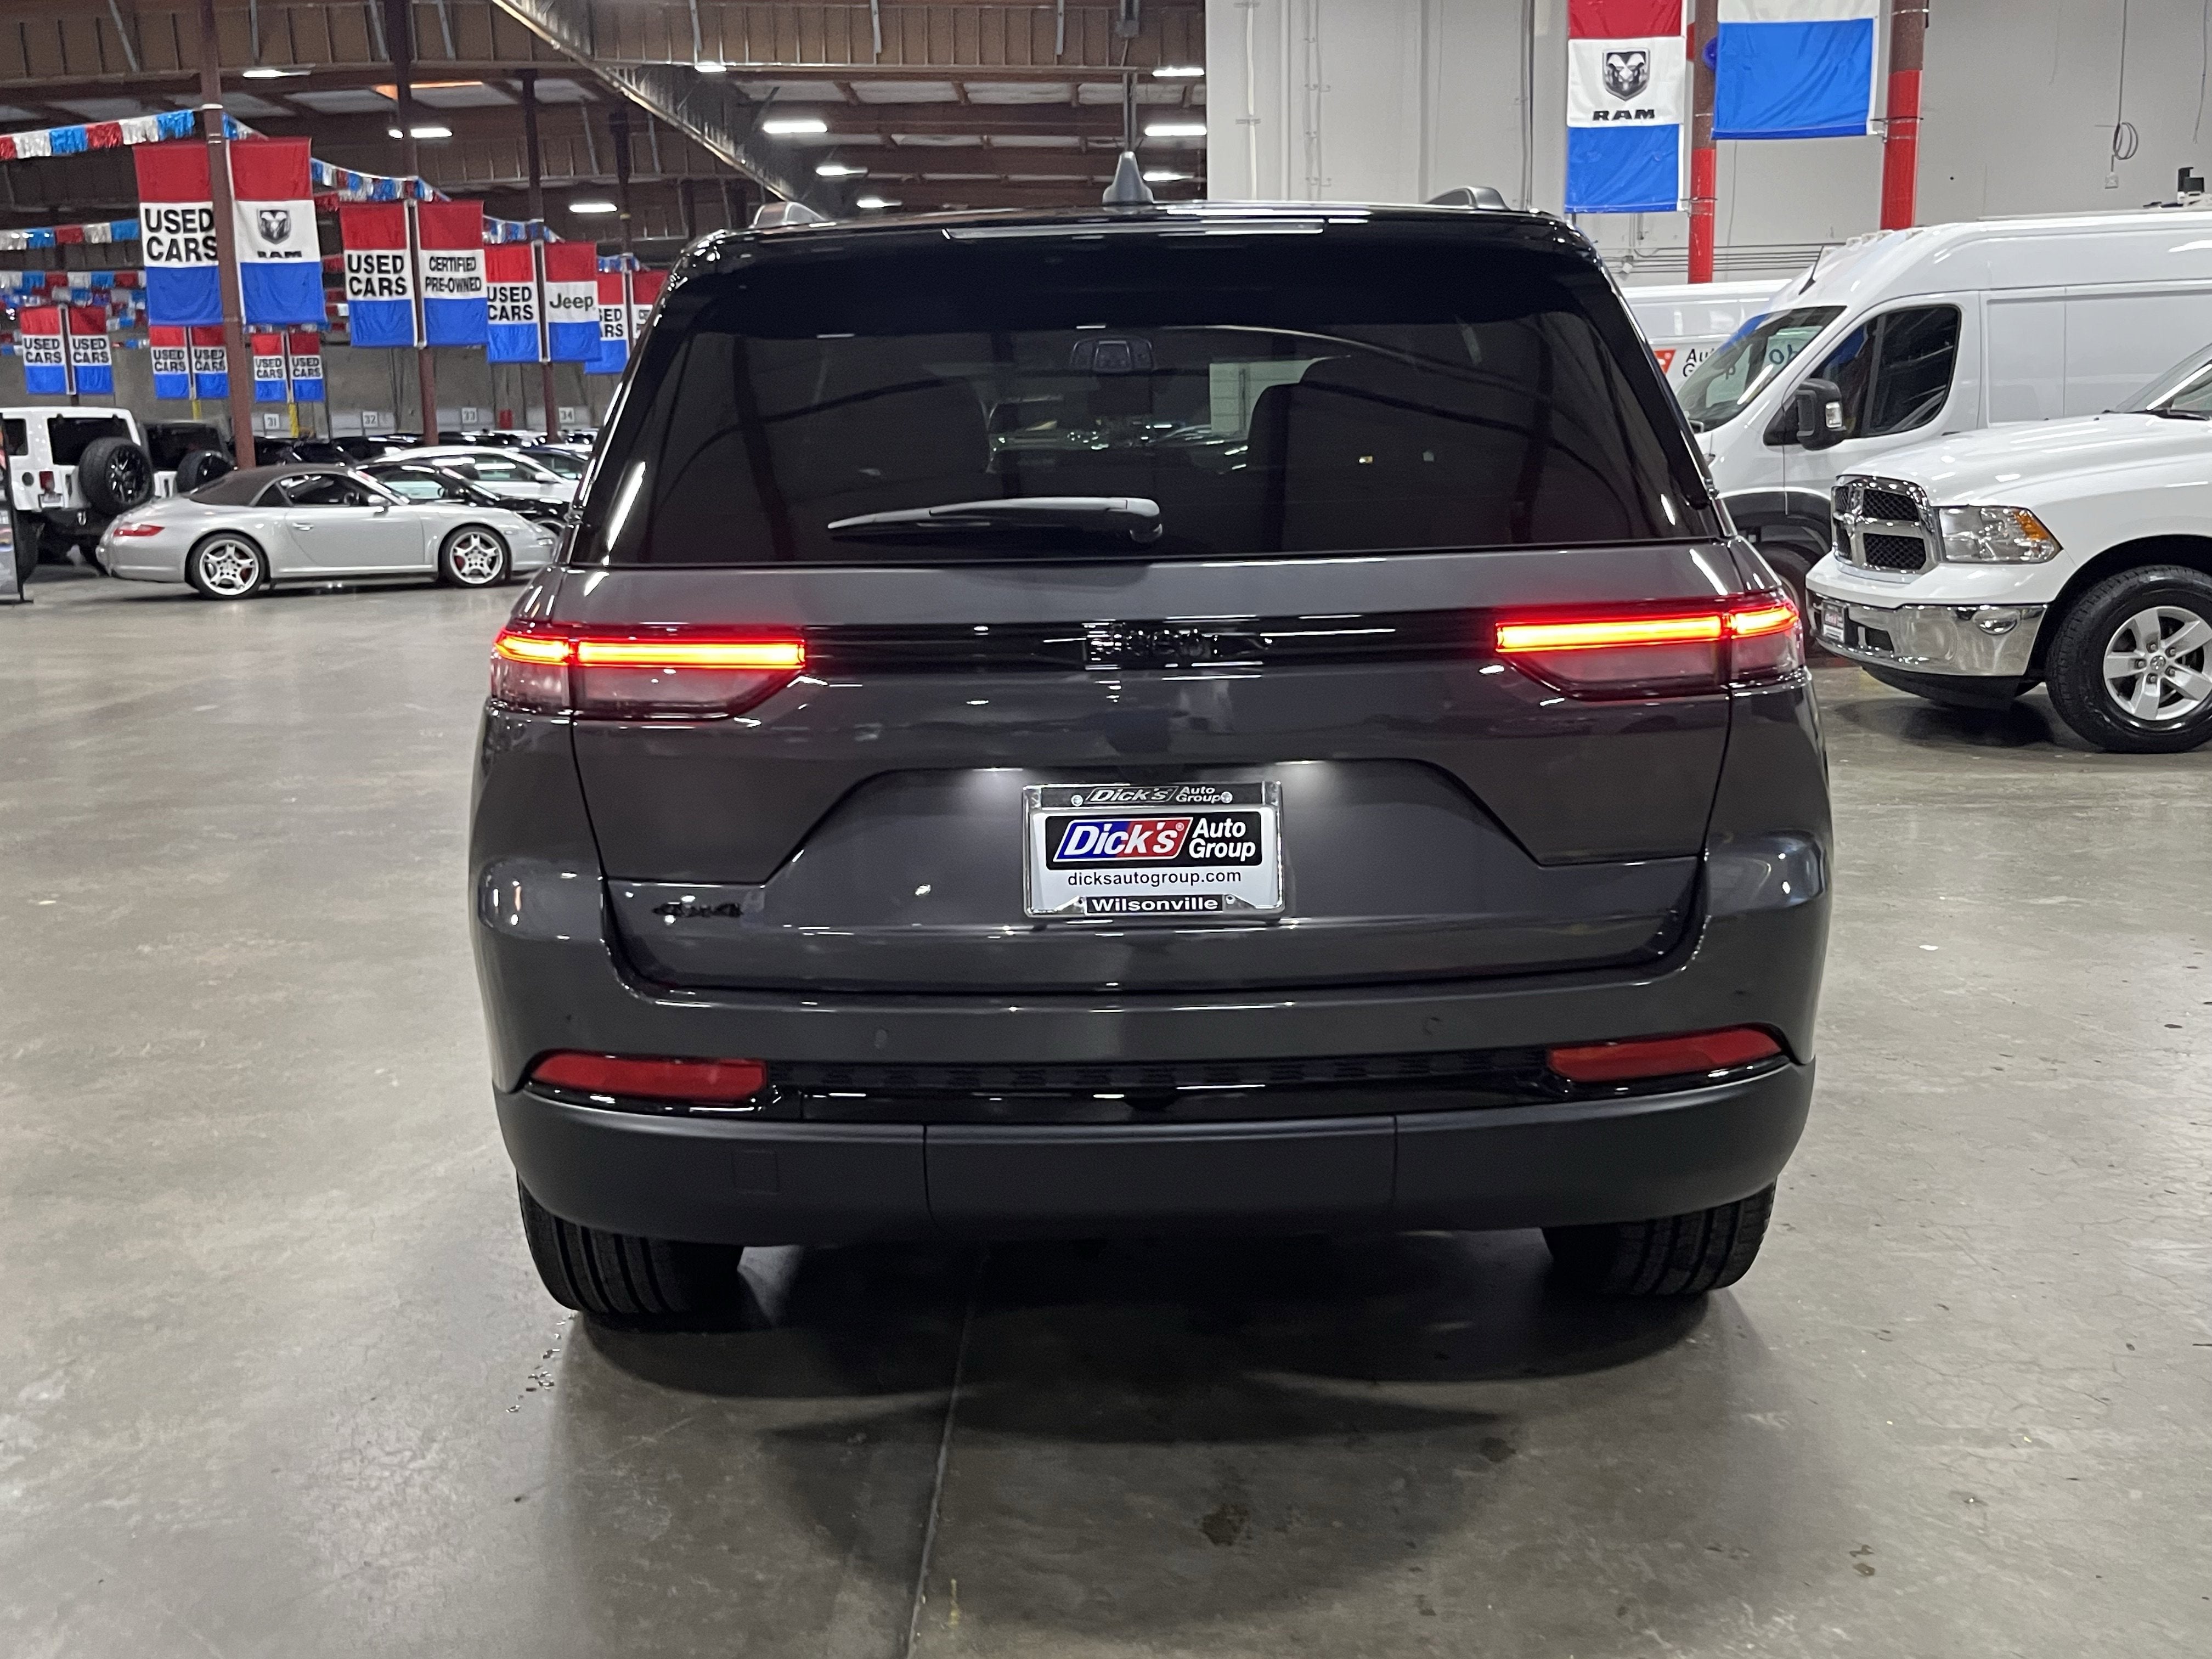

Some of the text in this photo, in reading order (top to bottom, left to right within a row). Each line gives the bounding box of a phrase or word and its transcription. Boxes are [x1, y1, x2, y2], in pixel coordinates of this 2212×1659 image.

[1592, 109, 1655, 121] RAM
[145, 208, 213, 234] USED
[146, 236, 217, 262] CARS
[347, 254, 405, 274] USED
[429, 256, 477, 272] CERTIFIED
[349, 276, 408, 297] CARS
[425, 276, 482, 293] PRE-OWNED
[487, 286, 532, 303] USED
[549, 293, 594, 311] Jeep
[487, 304, 534, 321] CARS
[24, 338, 60, 350] USED
[72, 338, 107, 350] USED
[25, 352, 62, 363] CARS
[73, 352, 109, 363] CARS
[154, 349, 184, 360] USED
[194, 349, 224, 359] USED
[155, 362, 186, 371] CARS
[195, 360, 226, 371] CARS
[255, 358, 282, 368] USED
[292, 358, 319, 366] USED
[256, 369, 283, 378] CARS
[293, 368, 320, 377] CARS
[364, 415, 376, 424] 32
[560, 410, 573, 420] 34
[1090, 789, 1168, 802] Dick's
[1179, 786, 1216, 794] Auto
[1175, 794, 1221, 804] Group
[1192, 818, 1246, 838] Auto
[1063, 822, 1176, 856] Dick's
[1189, 839, 1256, 861] Group
[1068, 871, 1242, 887] dicksautogroup.com
[1090, 895, 1218, 912] Wilsonville
